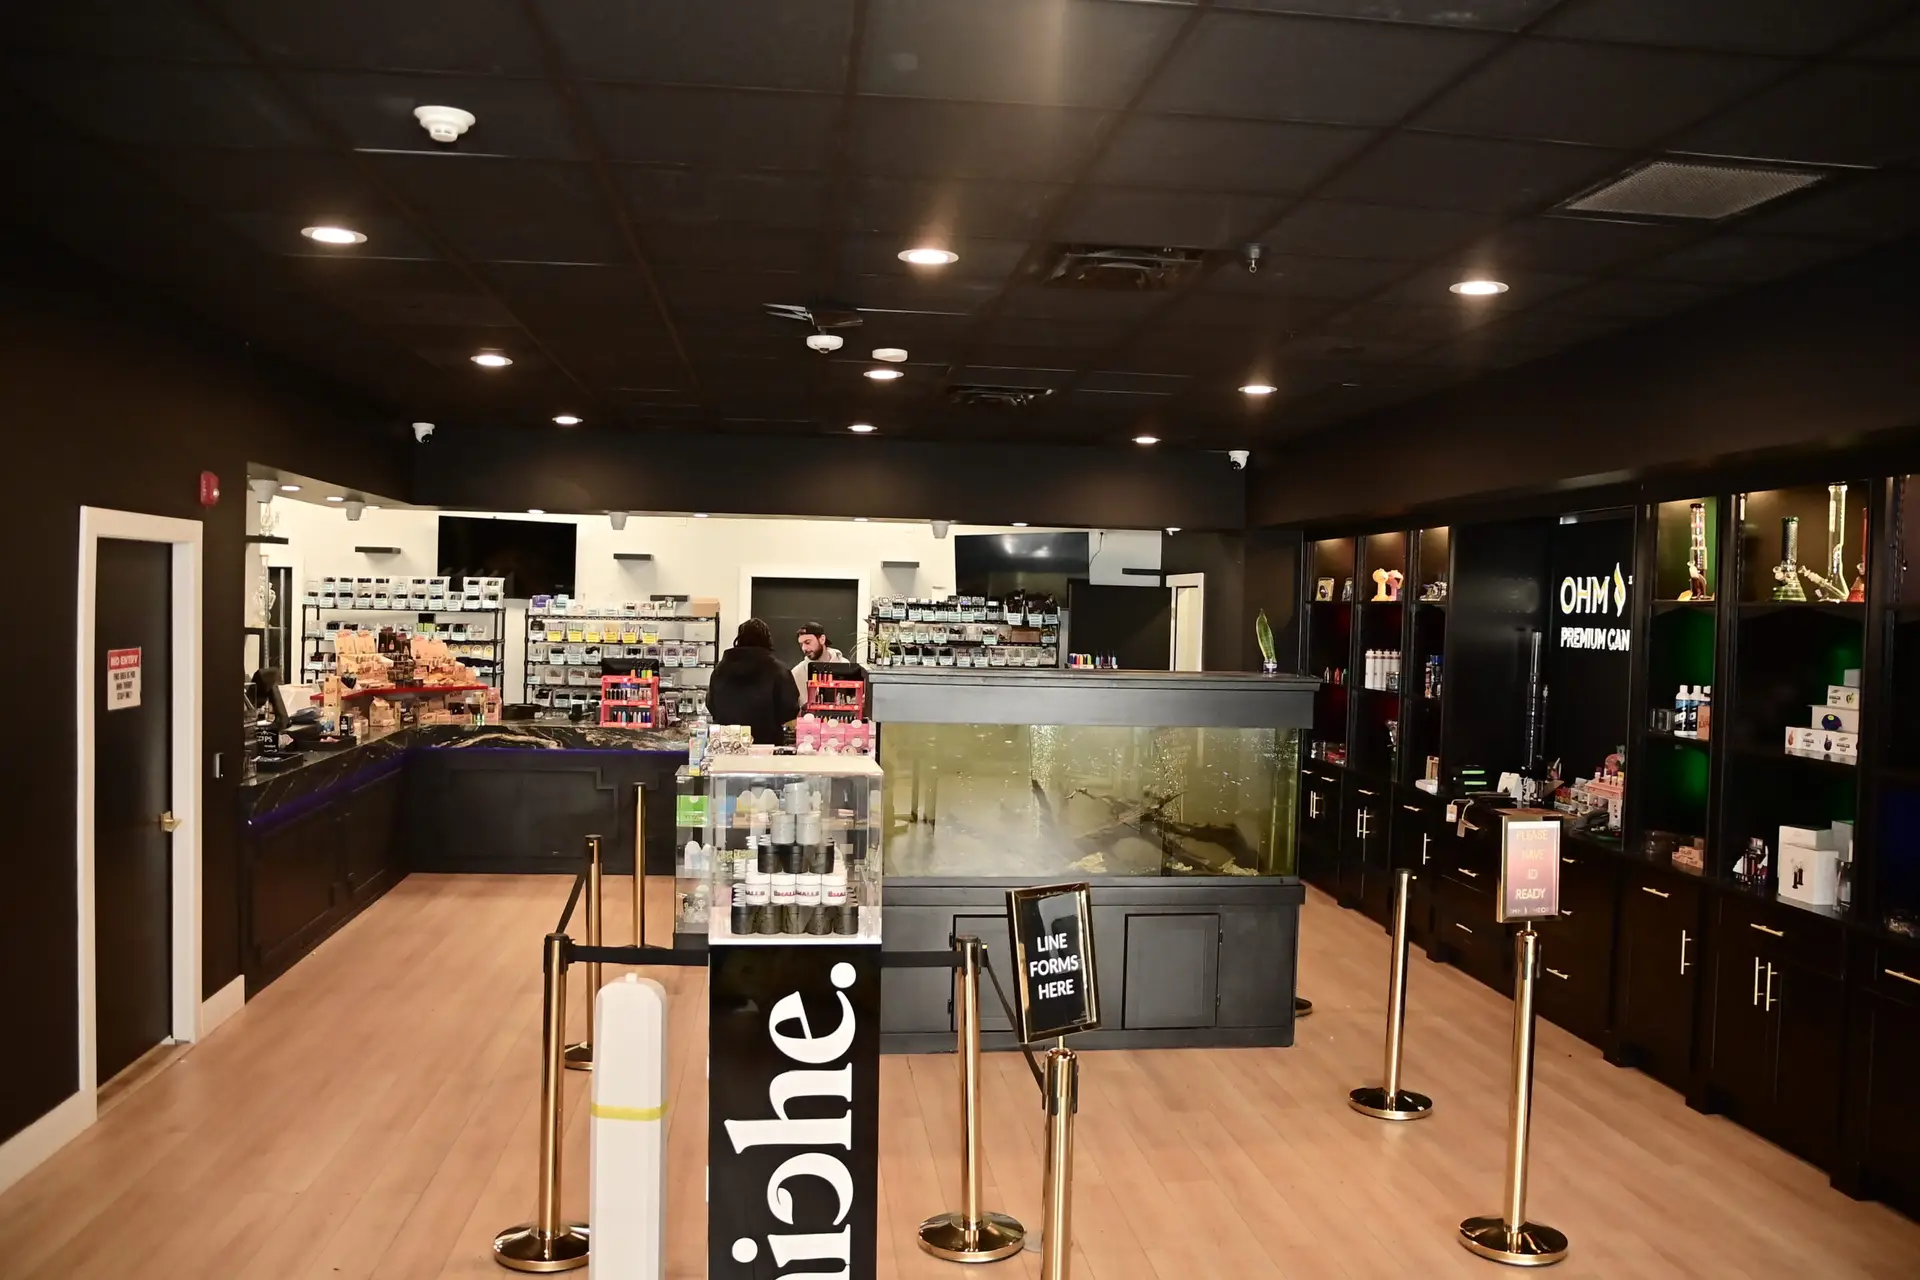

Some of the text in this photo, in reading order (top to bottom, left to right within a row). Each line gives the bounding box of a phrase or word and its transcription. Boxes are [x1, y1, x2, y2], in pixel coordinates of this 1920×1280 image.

[1560, 576, 1610, 614] OHM
[1560, 627, 1630, 651] PREMIUM CAN
[110, 654, 138, 666] NO ENTRY
[1516, 830, 1548, 841] PLEASE
[1522, 849, 1545, 860] HAVE
[1527, 868, 1538, 880] ID
[1515, 888, 1546, 900] READY
[1037, 932, 1068, 952] LINE
[1029, 954, 1079, 977] FORMS
[1038, 978, 1074, 1000] HERE
[724, 962, 857, 1280] iche.
